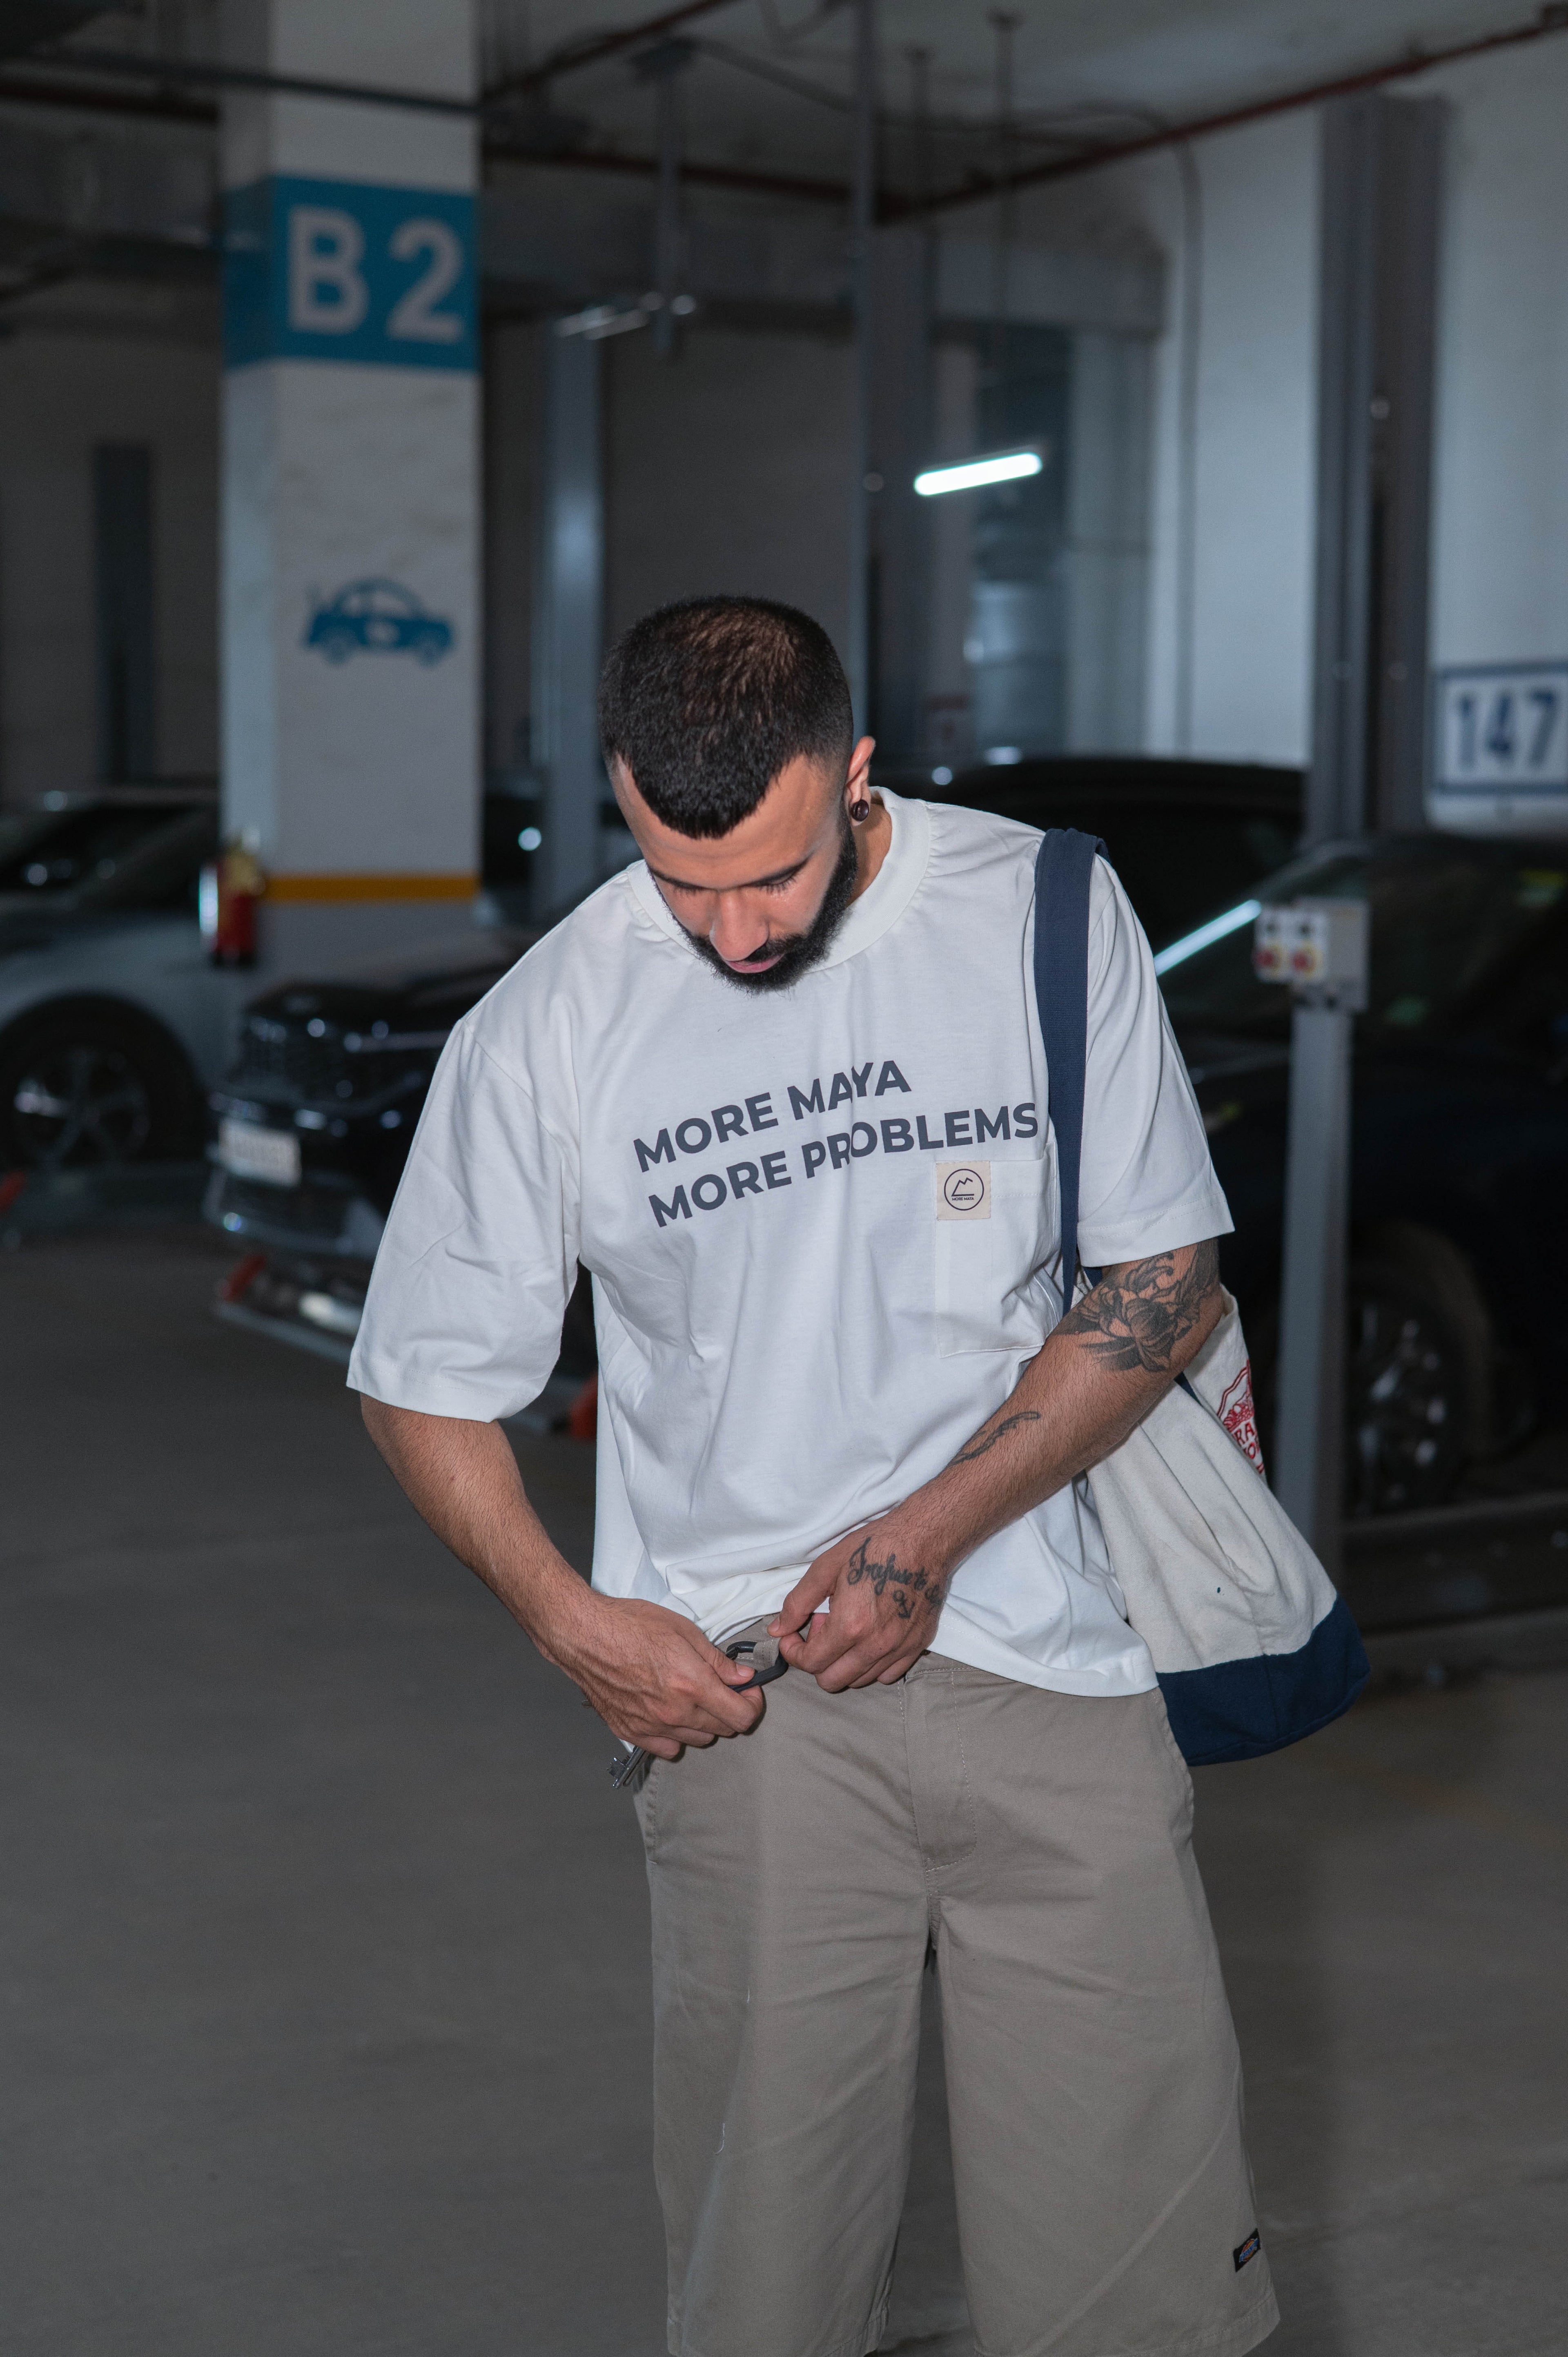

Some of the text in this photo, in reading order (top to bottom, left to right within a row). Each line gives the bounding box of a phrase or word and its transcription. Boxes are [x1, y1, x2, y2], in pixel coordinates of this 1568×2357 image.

[1454, 687, 1557, 769] 147
[633, 1060, 912, 1173] MORE MAYA
[648, 1102, 1038, 1228] MORE PROBLEMS
